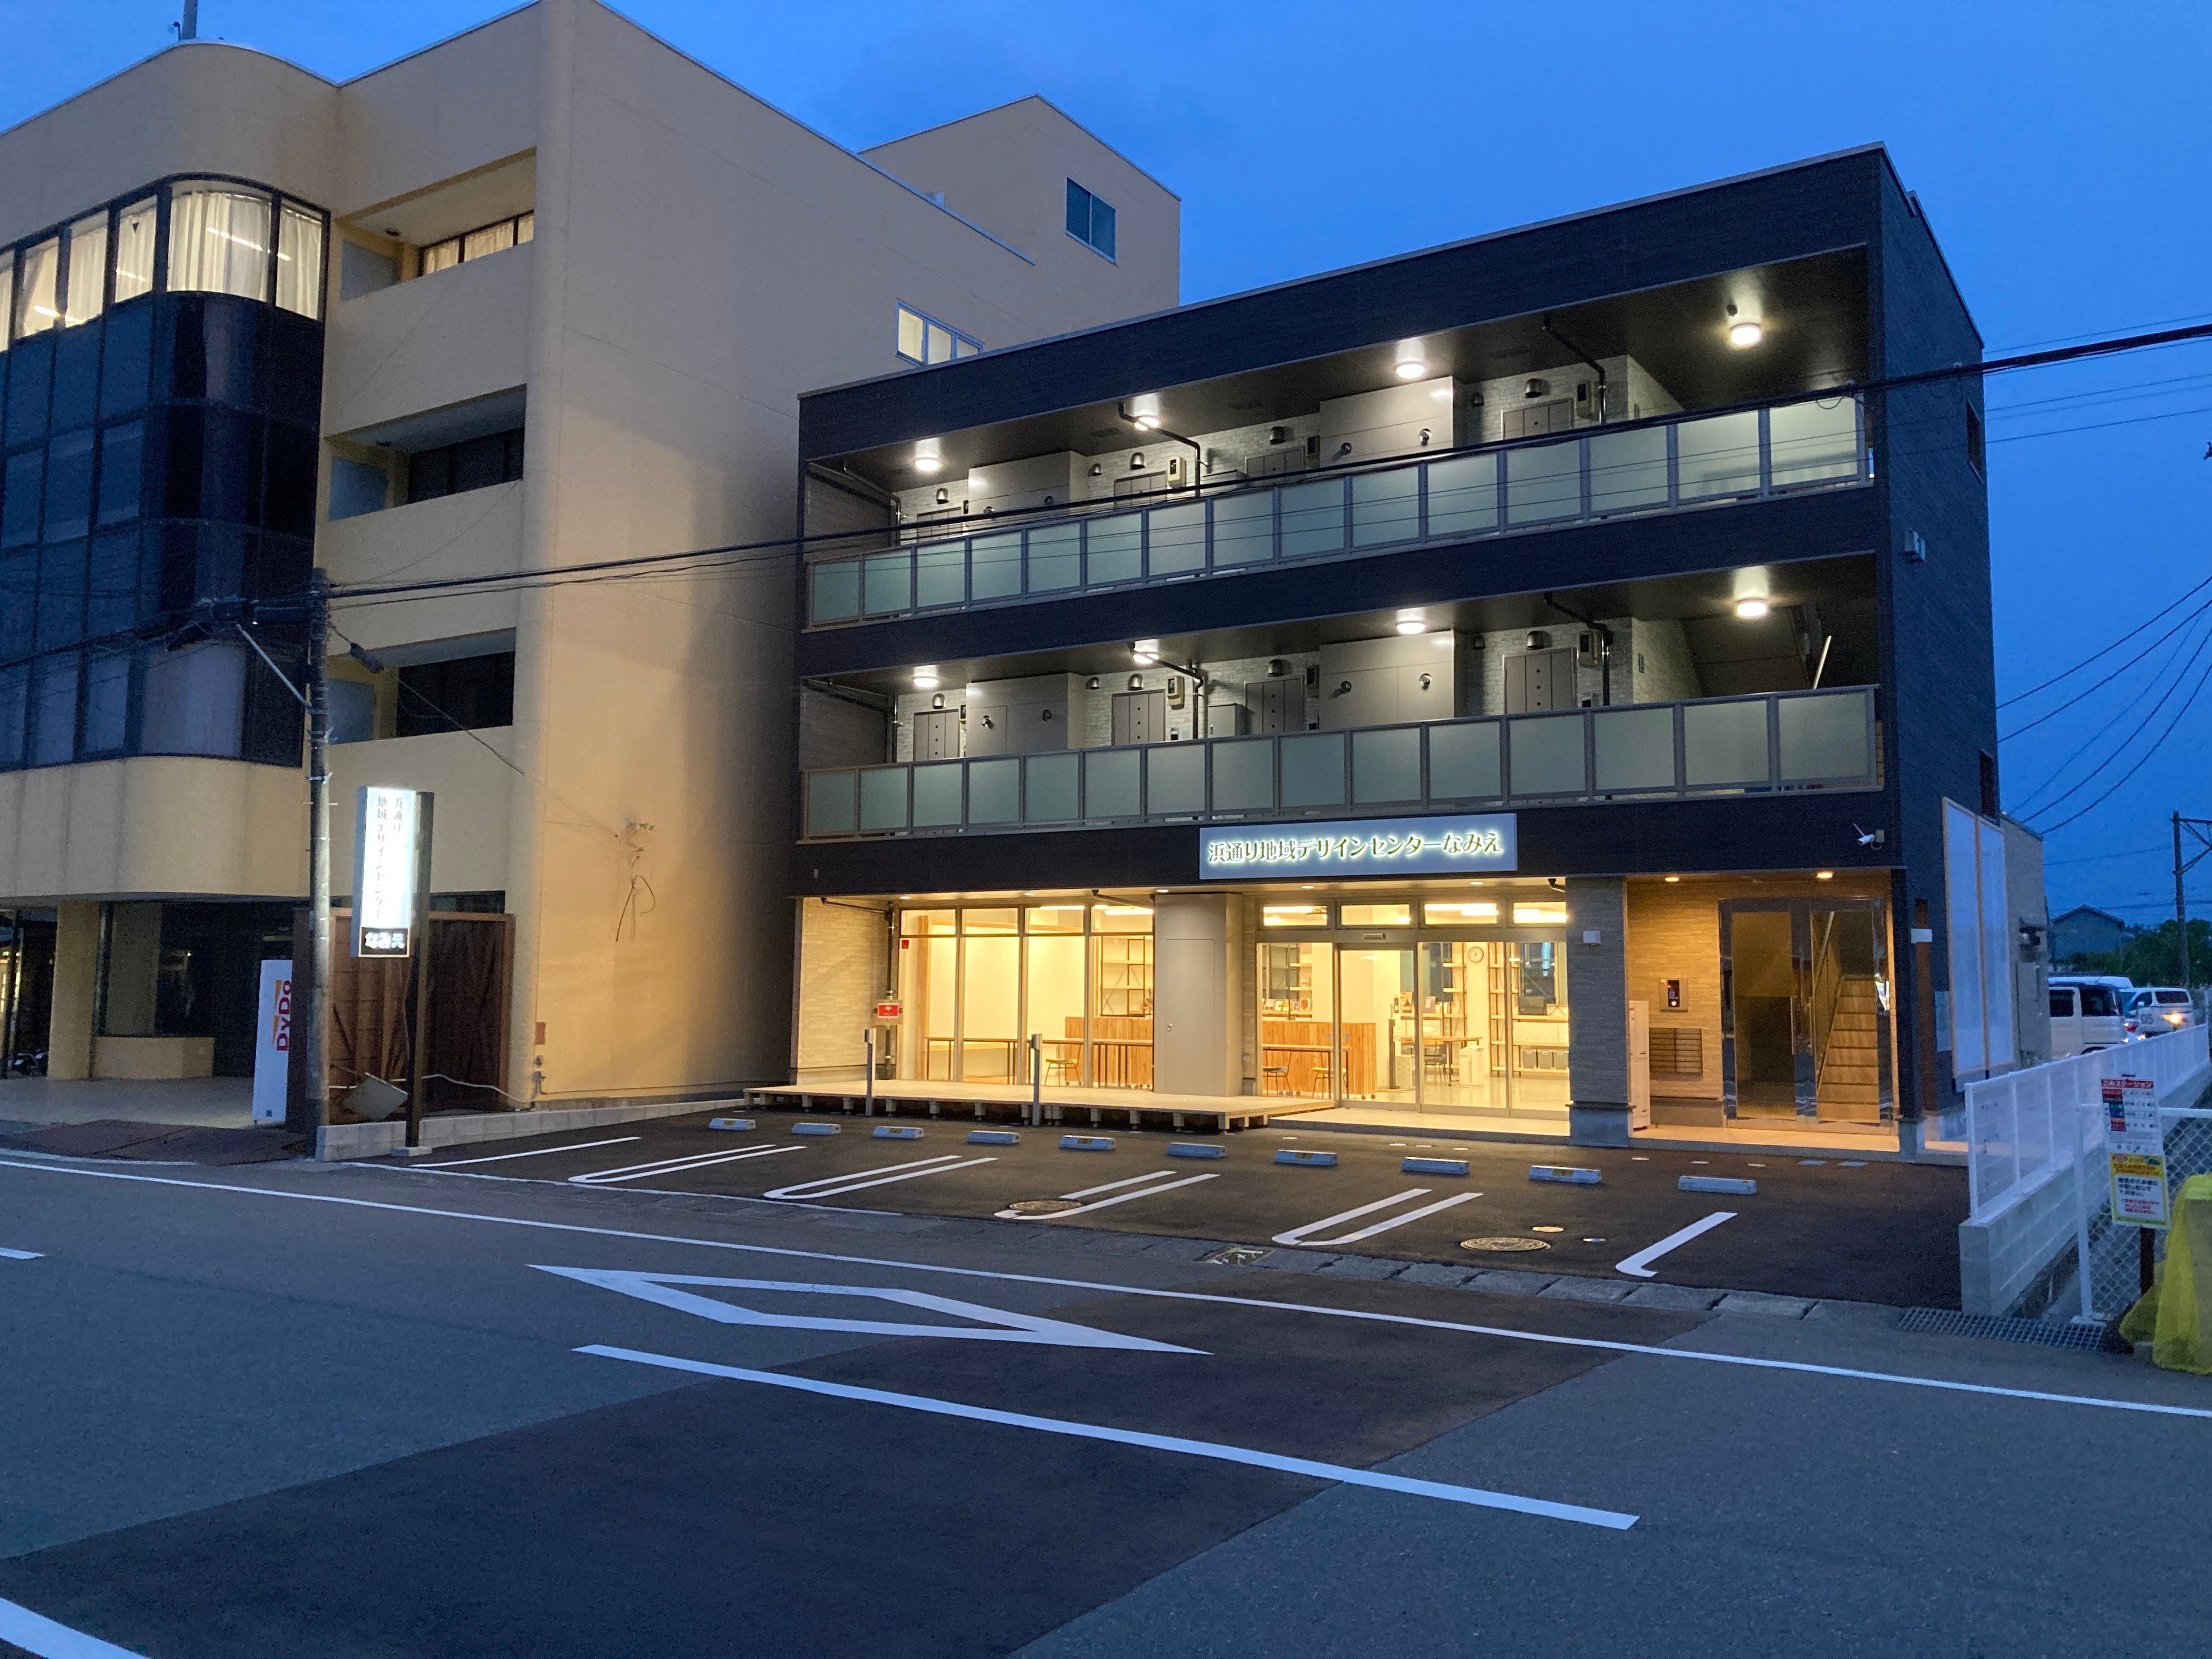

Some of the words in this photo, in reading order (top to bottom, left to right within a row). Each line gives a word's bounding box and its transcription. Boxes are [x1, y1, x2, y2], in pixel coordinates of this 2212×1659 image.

[1208, 831, 1502, 863] 浜通り地域デザインセンターなみえ
[365, 931, 405, 949] なみえ
